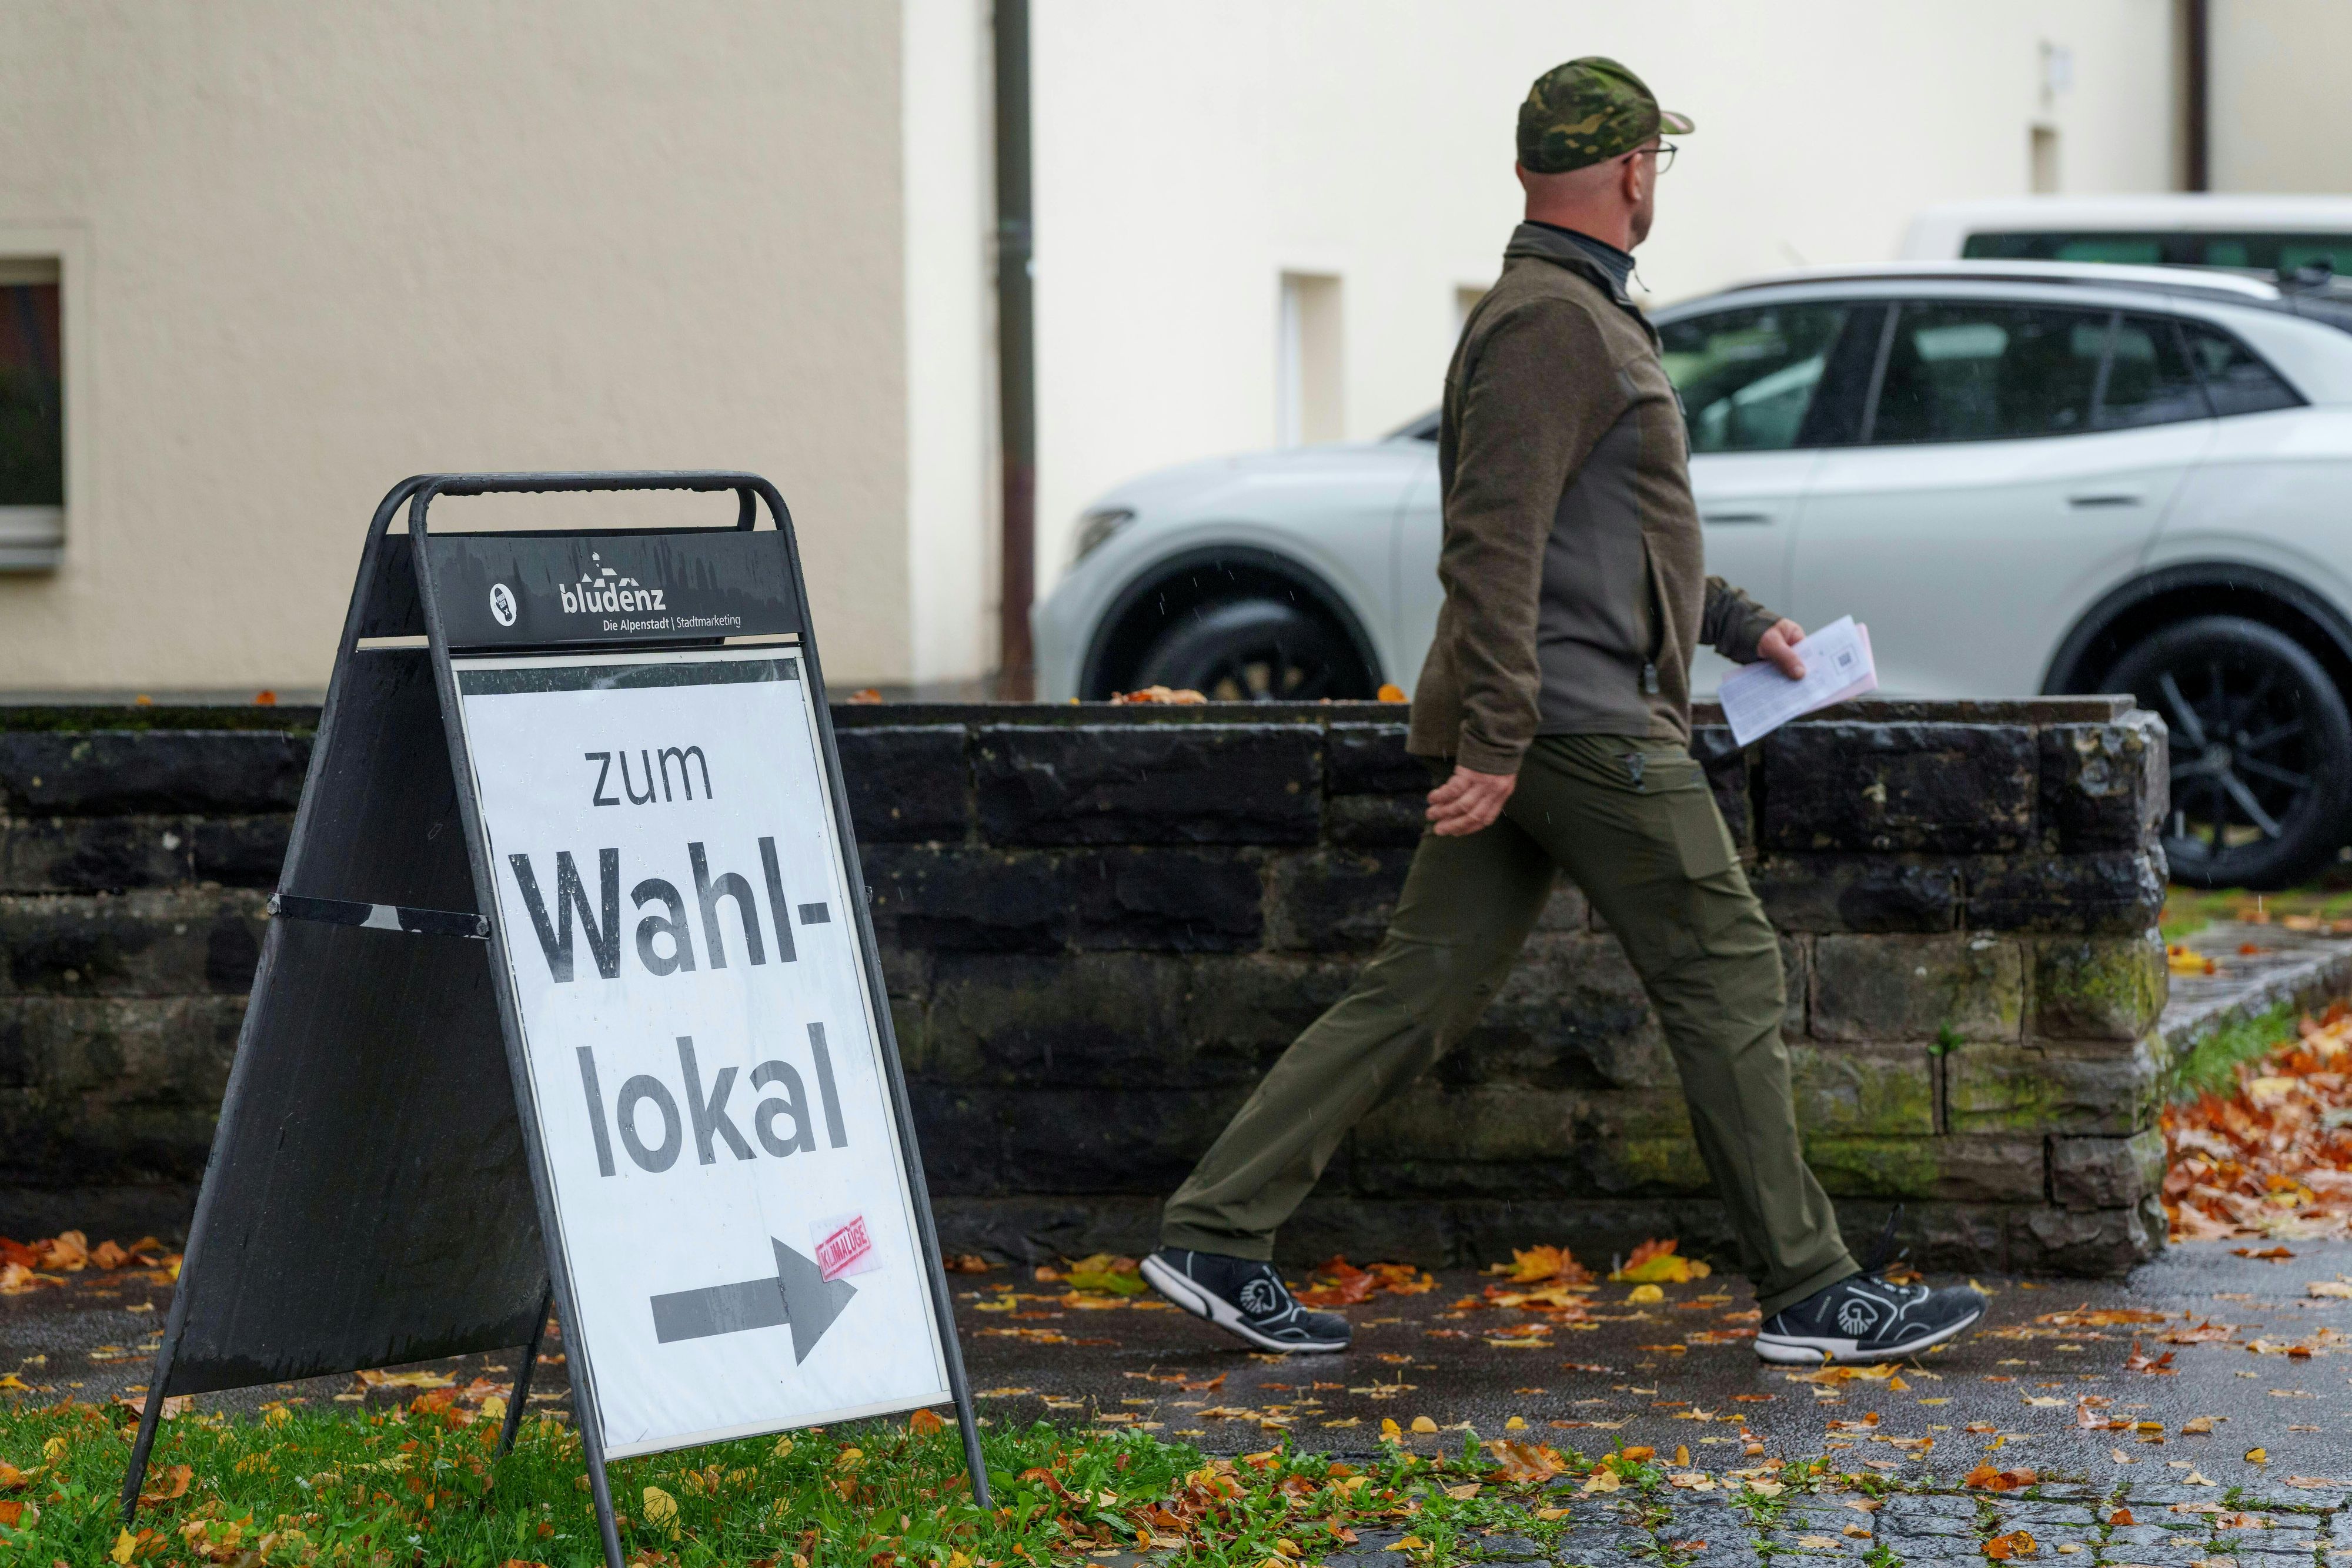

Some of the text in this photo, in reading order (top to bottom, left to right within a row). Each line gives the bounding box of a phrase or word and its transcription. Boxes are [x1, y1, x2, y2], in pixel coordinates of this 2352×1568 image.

[559, 583, 666, 613] bludenz
[603, 620, 618, 631] Die
[620, 617, 670, 633] Alpenstadt
[676, 614, 741, 628] Stadtmarketing
[584, 745, 713, 807] zum
[507, 836, 831, 983] Wahl-
[576, 1022, 848, 1178] lokal
[821, 1225, 867, 1269] KLIMALÜGE
